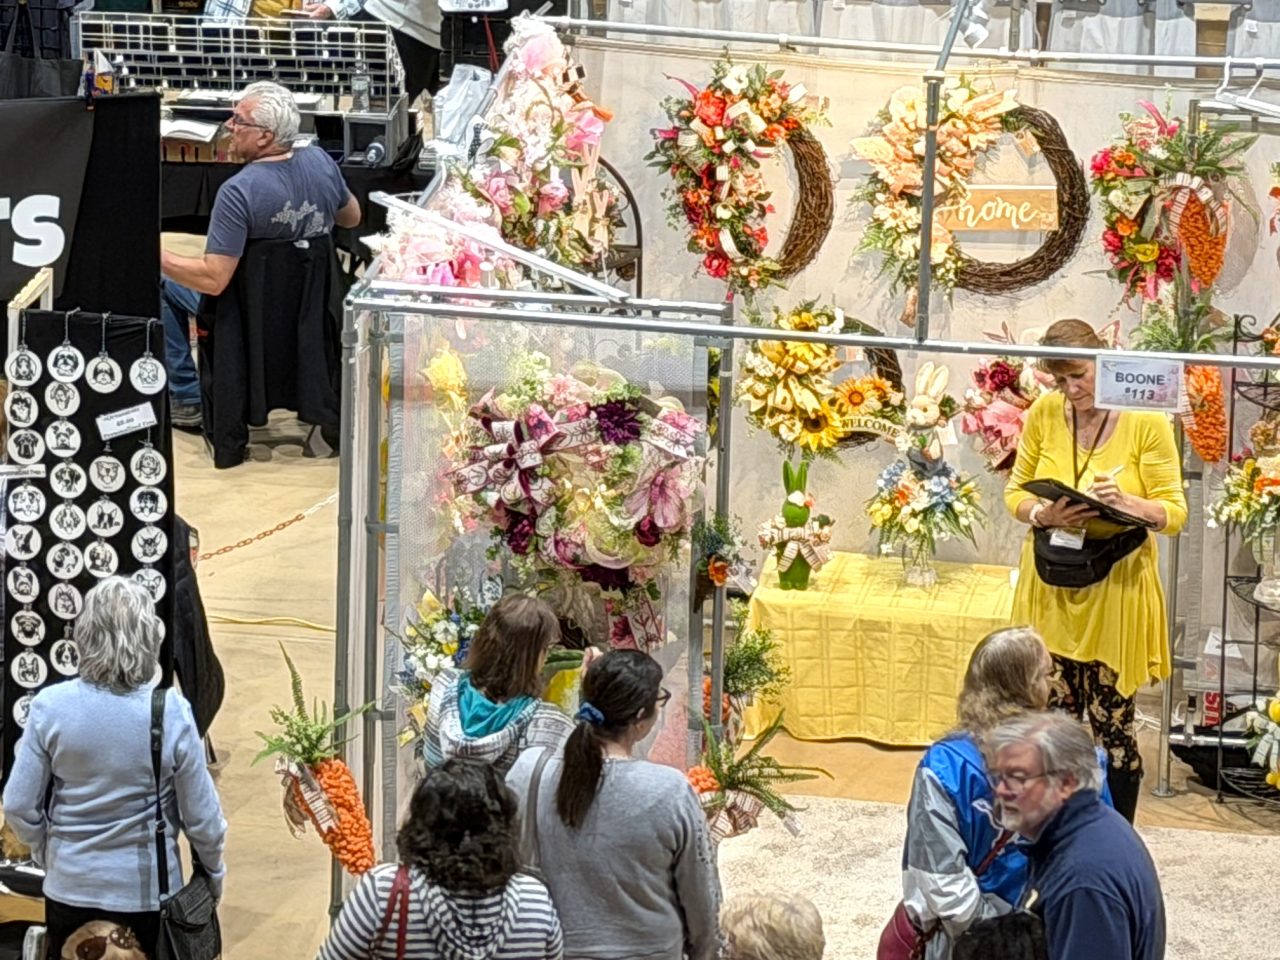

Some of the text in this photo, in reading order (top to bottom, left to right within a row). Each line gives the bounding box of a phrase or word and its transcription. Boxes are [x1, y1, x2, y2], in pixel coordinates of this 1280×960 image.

[1115, 371, 1165, 386] BOONE
[1125, 387, 1155, 400] #113
[840, 418, 900, 439] WELCOME
